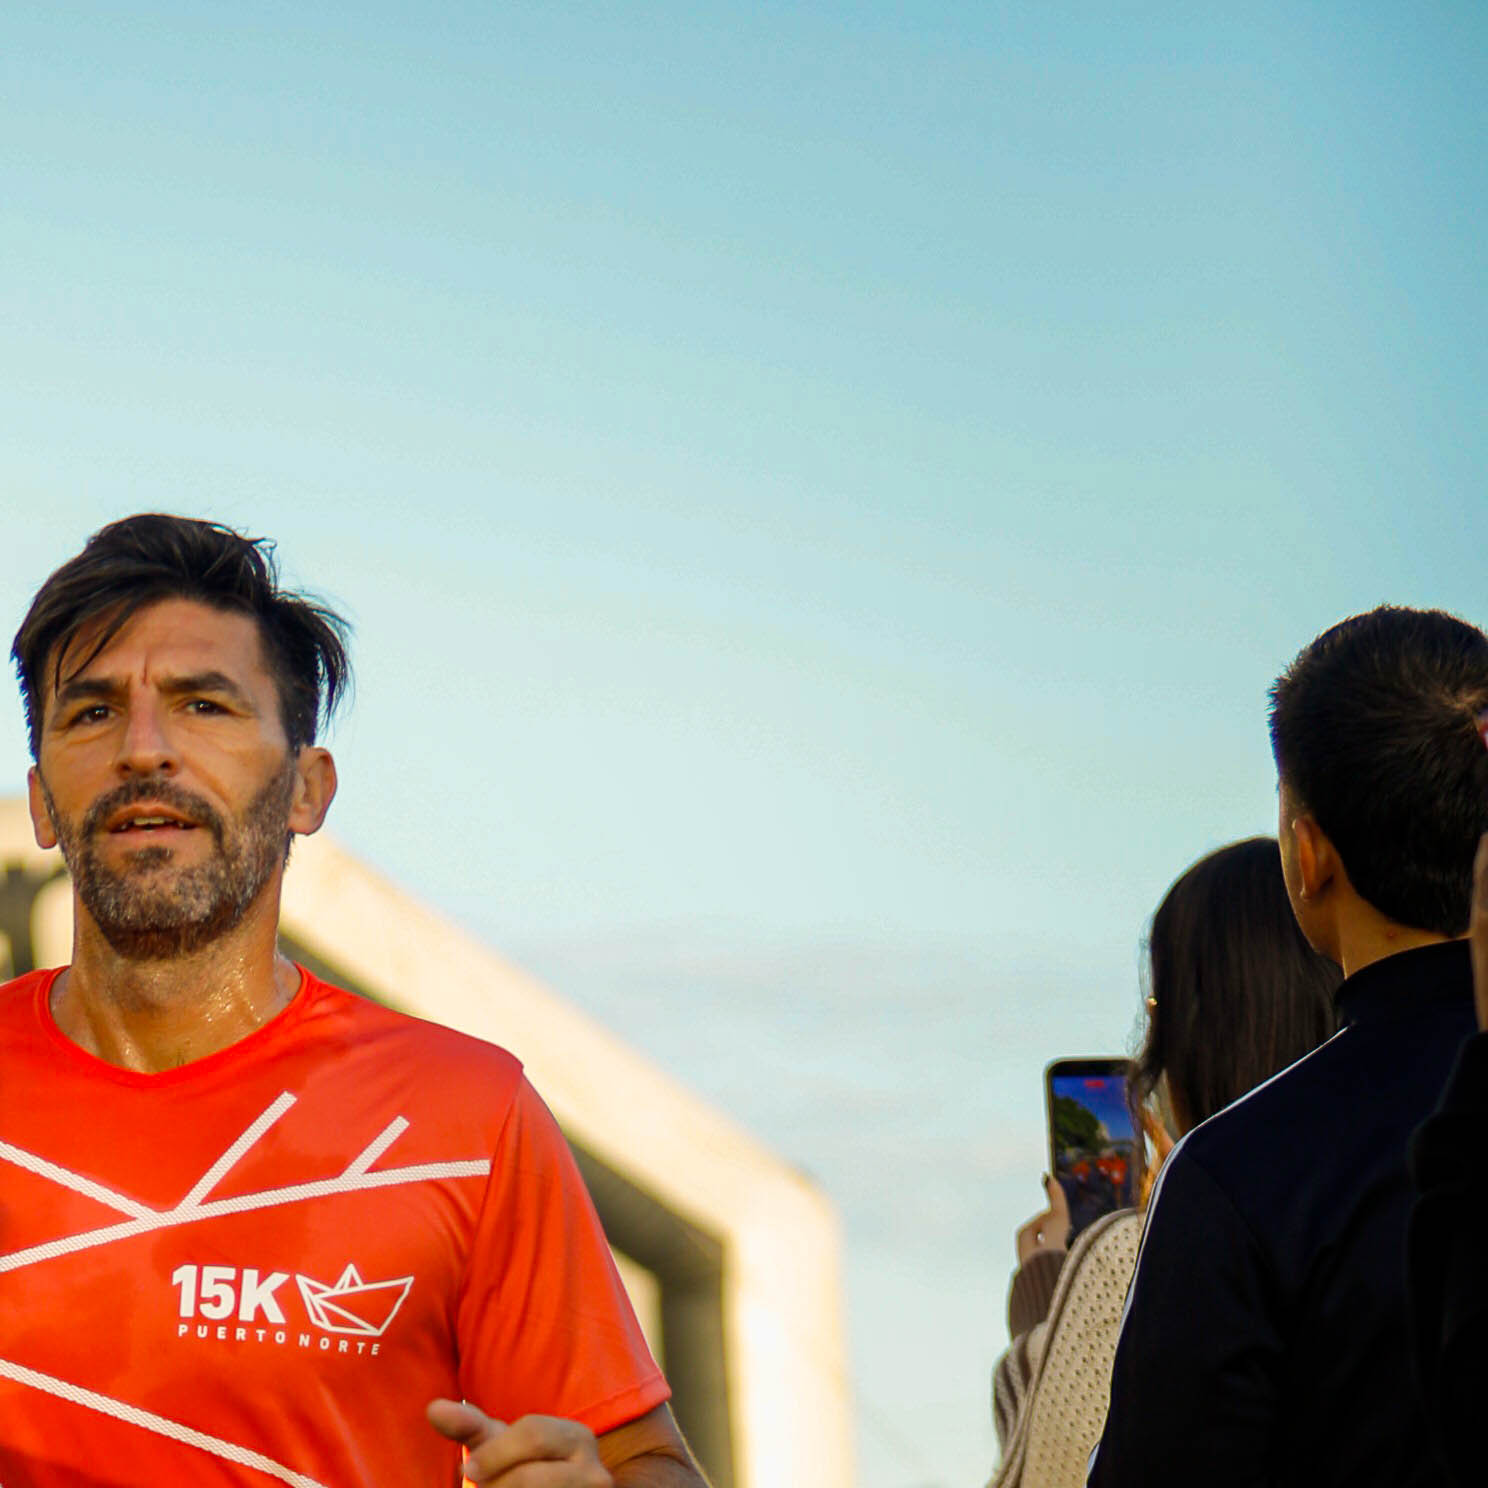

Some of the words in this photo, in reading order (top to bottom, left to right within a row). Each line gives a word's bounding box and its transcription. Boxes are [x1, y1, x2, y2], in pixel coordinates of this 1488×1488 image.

[172, 1264, 291, 1325] 15K
[178, 1323, 286, 1345] PUERTO
[298, 1333, 381, 1356] NORTE
